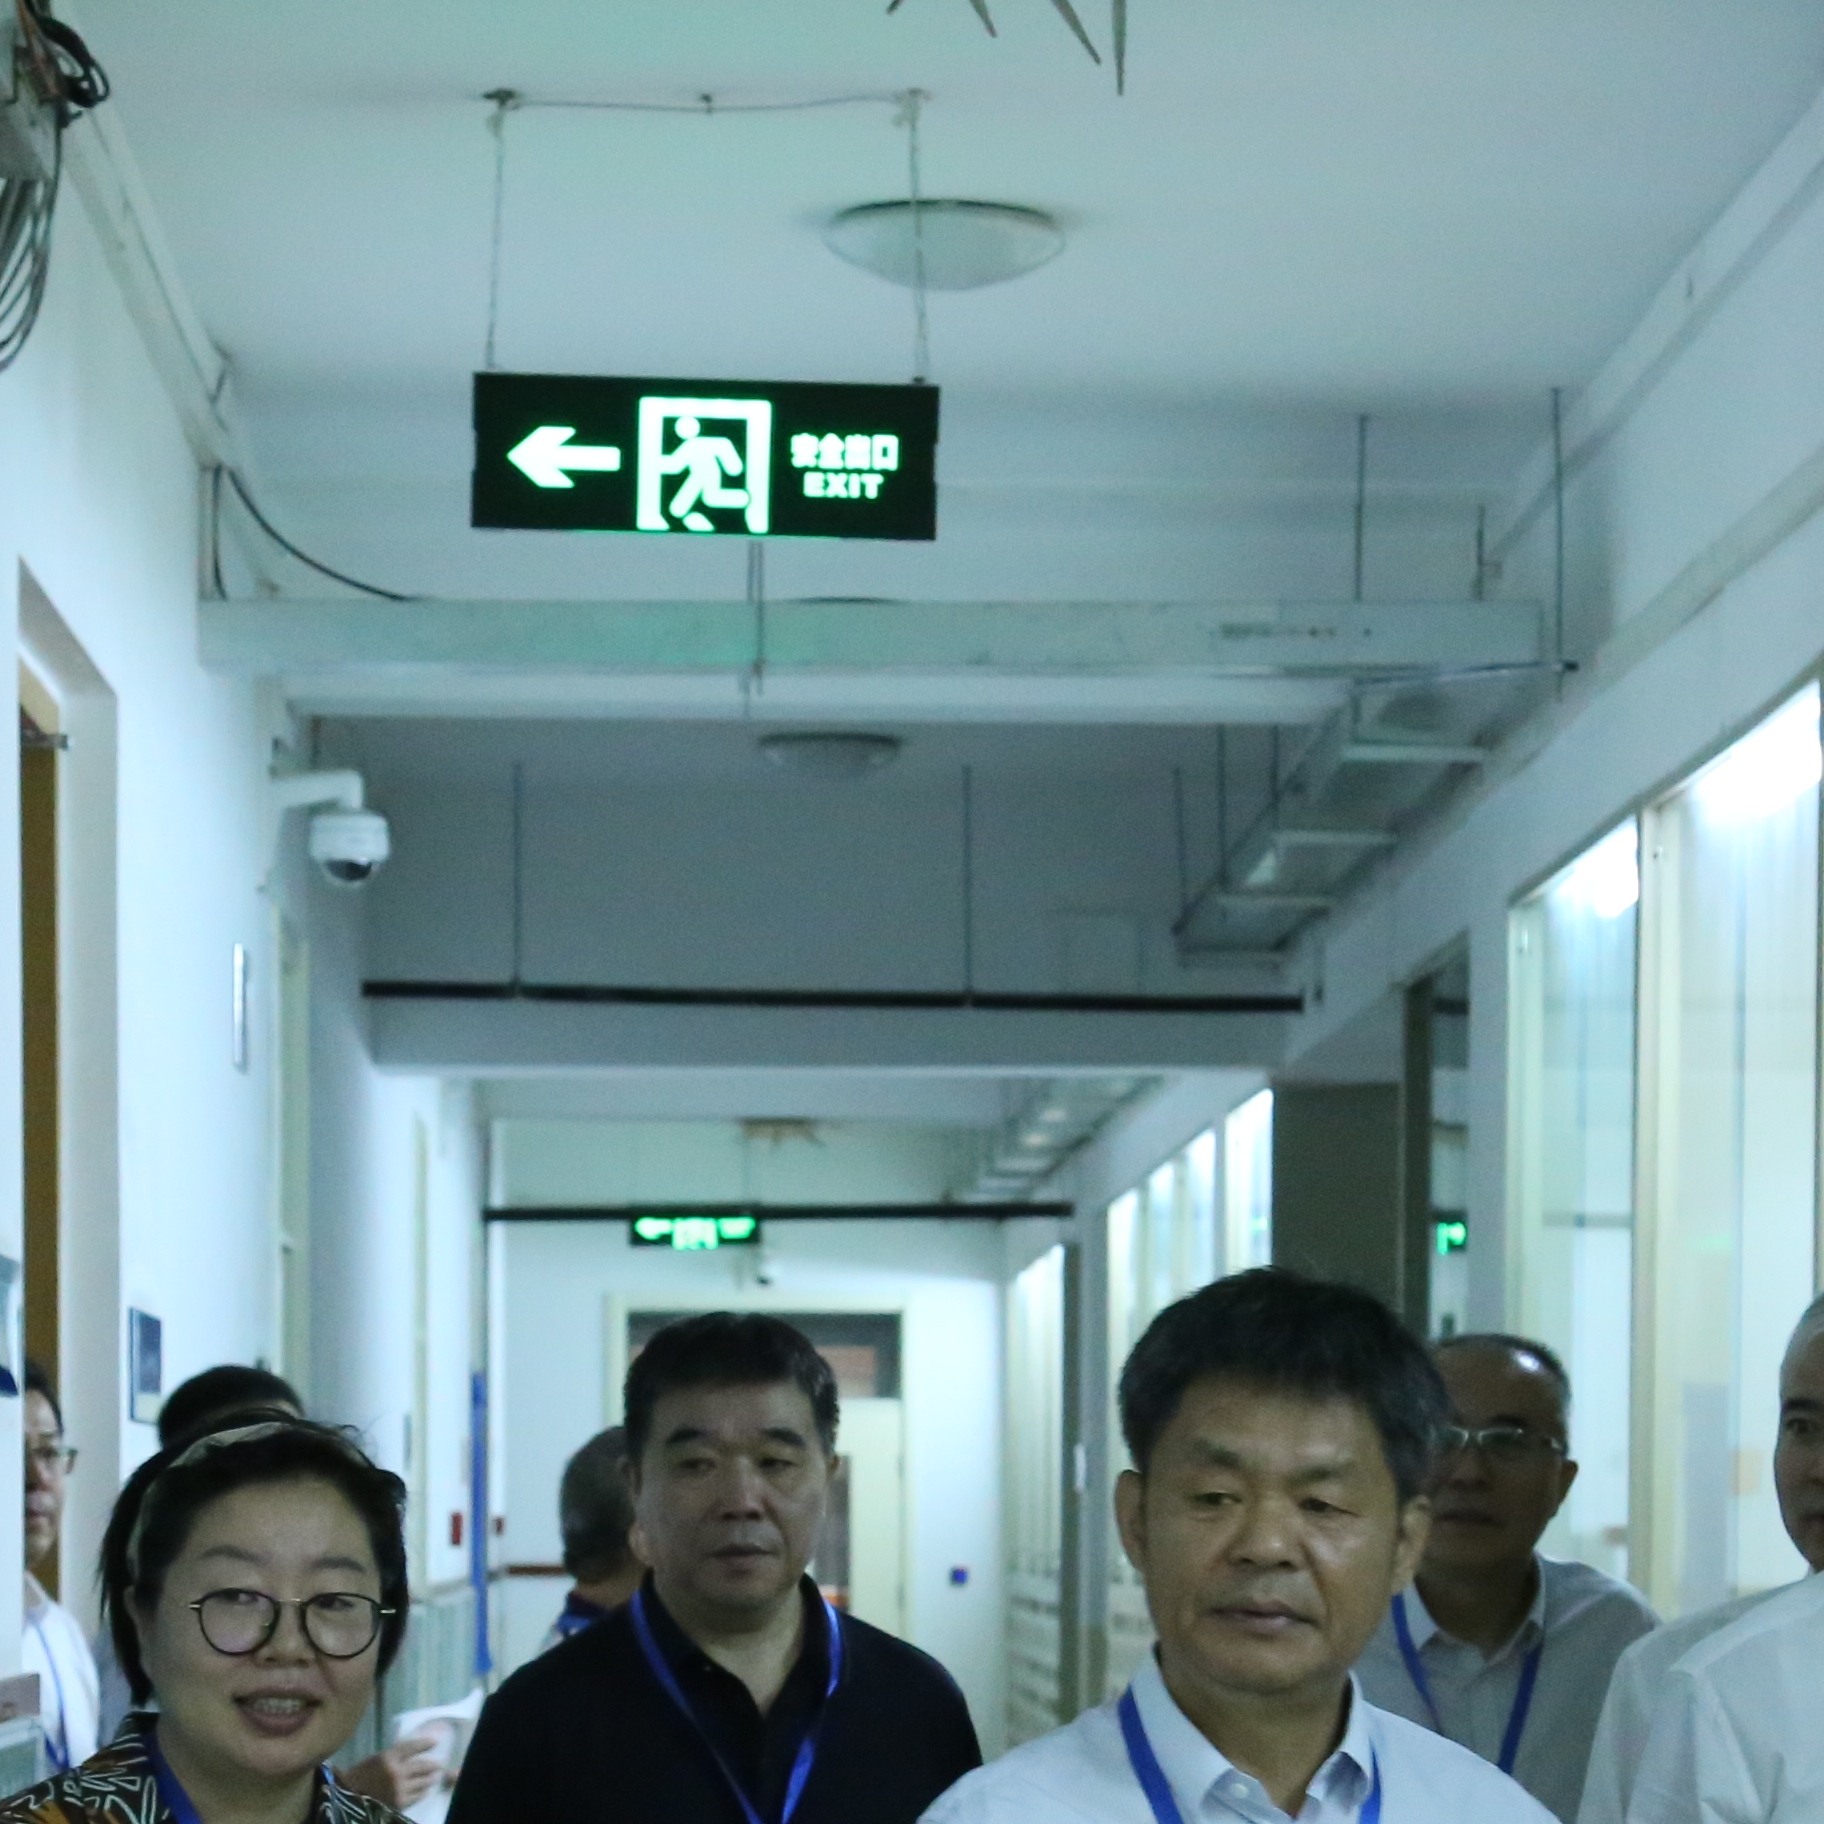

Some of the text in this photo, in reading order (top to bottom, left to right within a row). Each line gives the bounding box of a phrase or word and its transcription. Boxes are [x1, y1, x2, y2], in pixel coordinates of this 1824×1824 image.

[791, 432, 899, 470] 安全出口
[803, 471, 884, 499] EXIT
